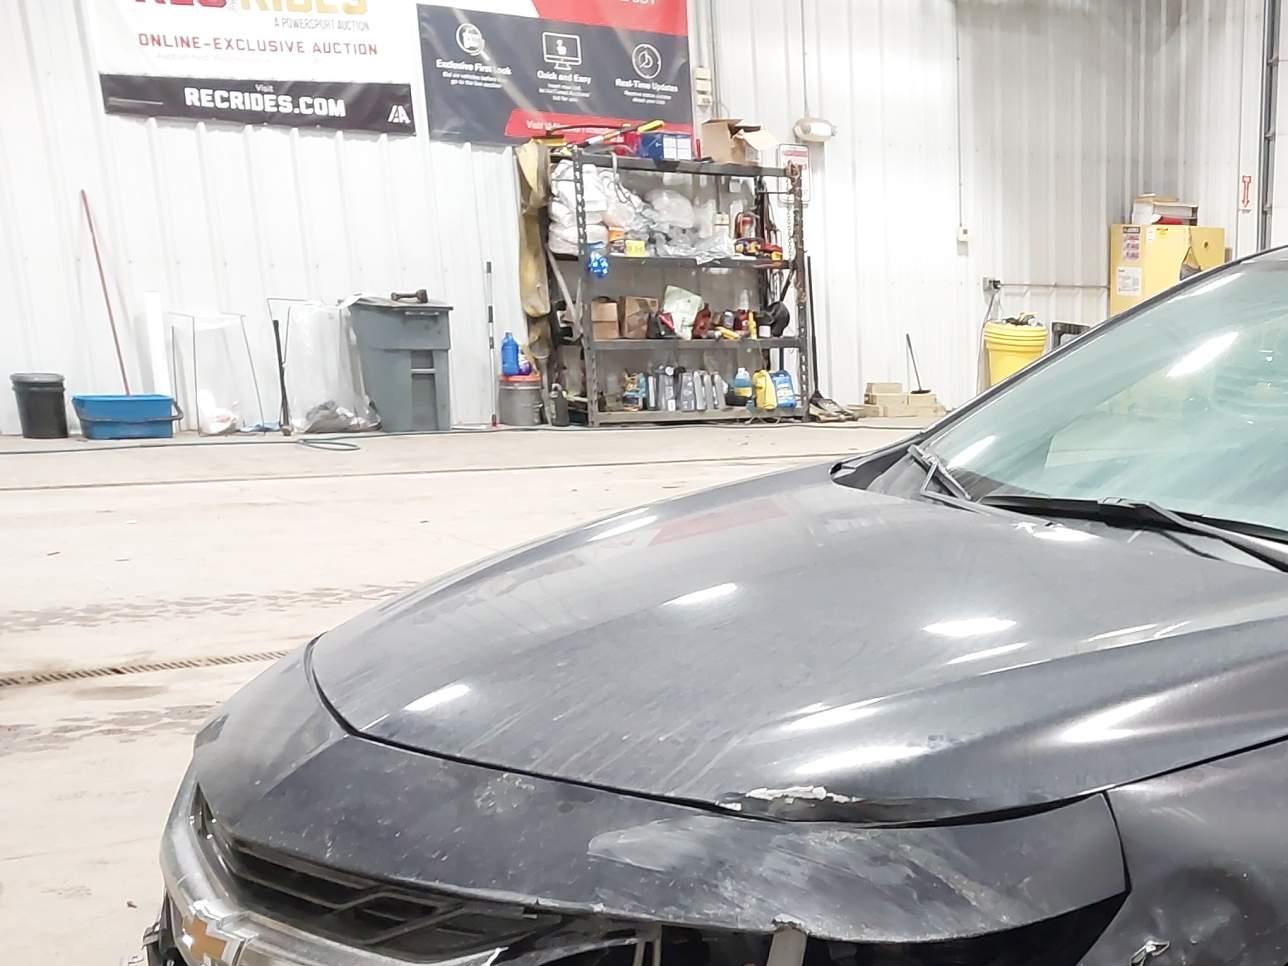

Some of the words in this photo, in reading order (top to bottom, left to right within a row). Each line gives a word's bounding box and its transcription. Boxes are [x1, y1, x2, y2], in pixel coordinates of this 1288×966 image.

[138, 33, 305, 54] ONLINE-EXCLUSIVE
[312, 42, 378, 56] AUCTION
[537, 70, 558, 81] Quick
[573, 74, 592, 85] Easy
[255, 84, 274, 92] Visit
[184, 87, 346, 117] RECRIDES.COM
